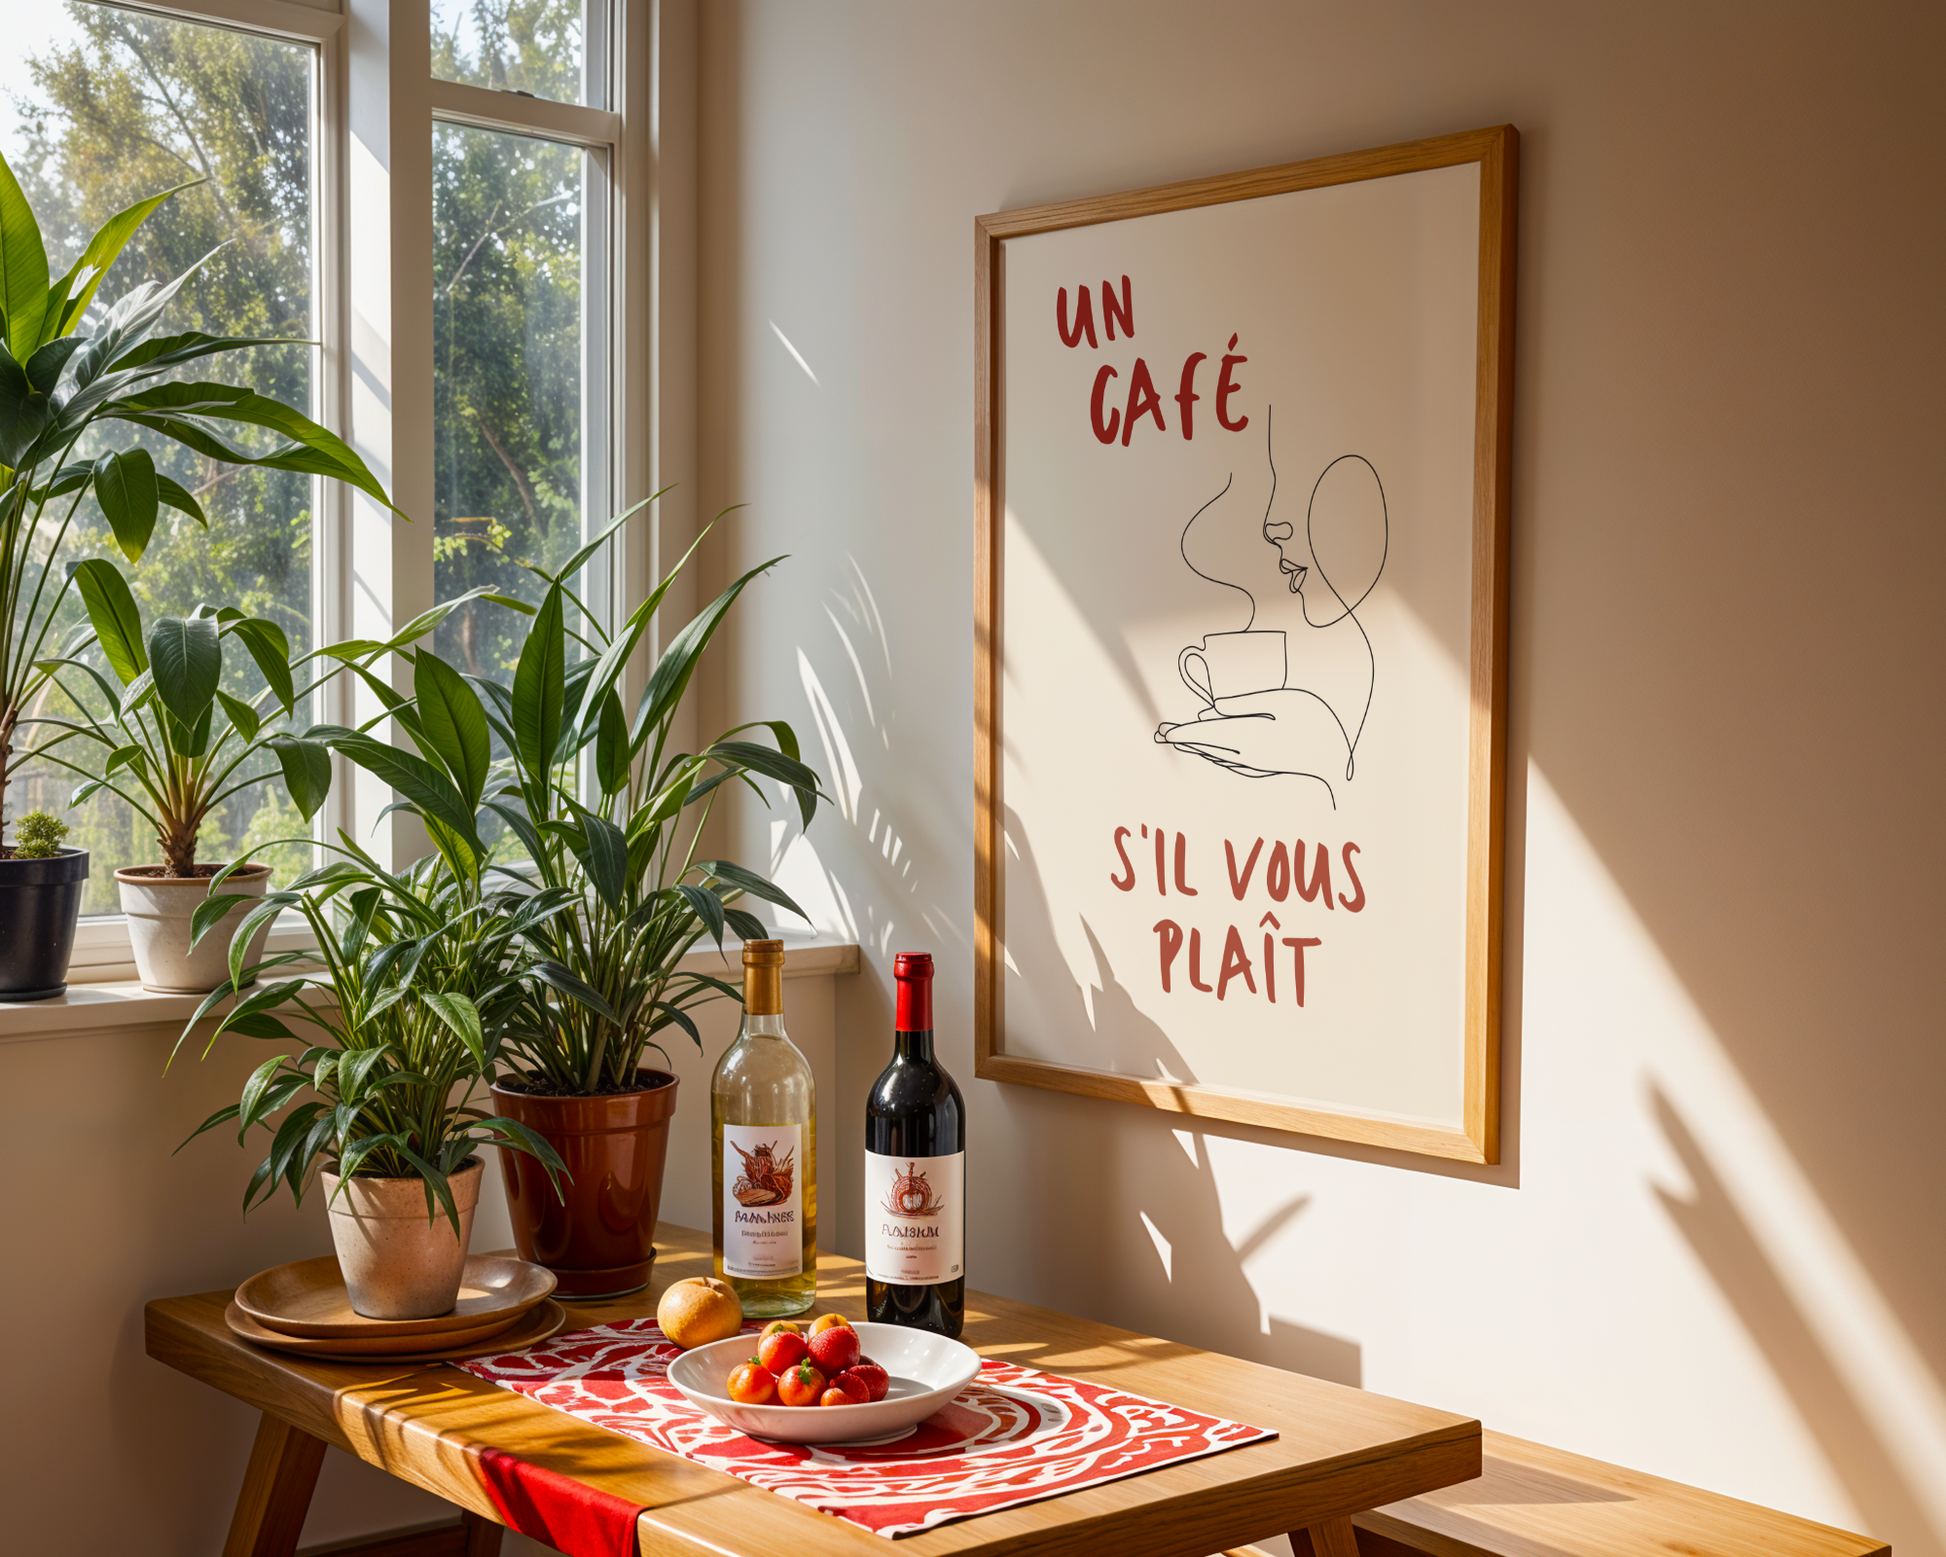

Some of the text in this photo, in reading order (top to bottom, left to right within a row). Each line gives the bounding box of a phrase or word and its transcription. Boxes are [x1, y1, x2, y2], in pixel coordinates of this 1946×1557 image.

[1056, 274, 1135, 349] UN
[1110, 823, 1366, 913] S'IL VOUS
[1152, 911, 1322, 1008] PLAÎT
